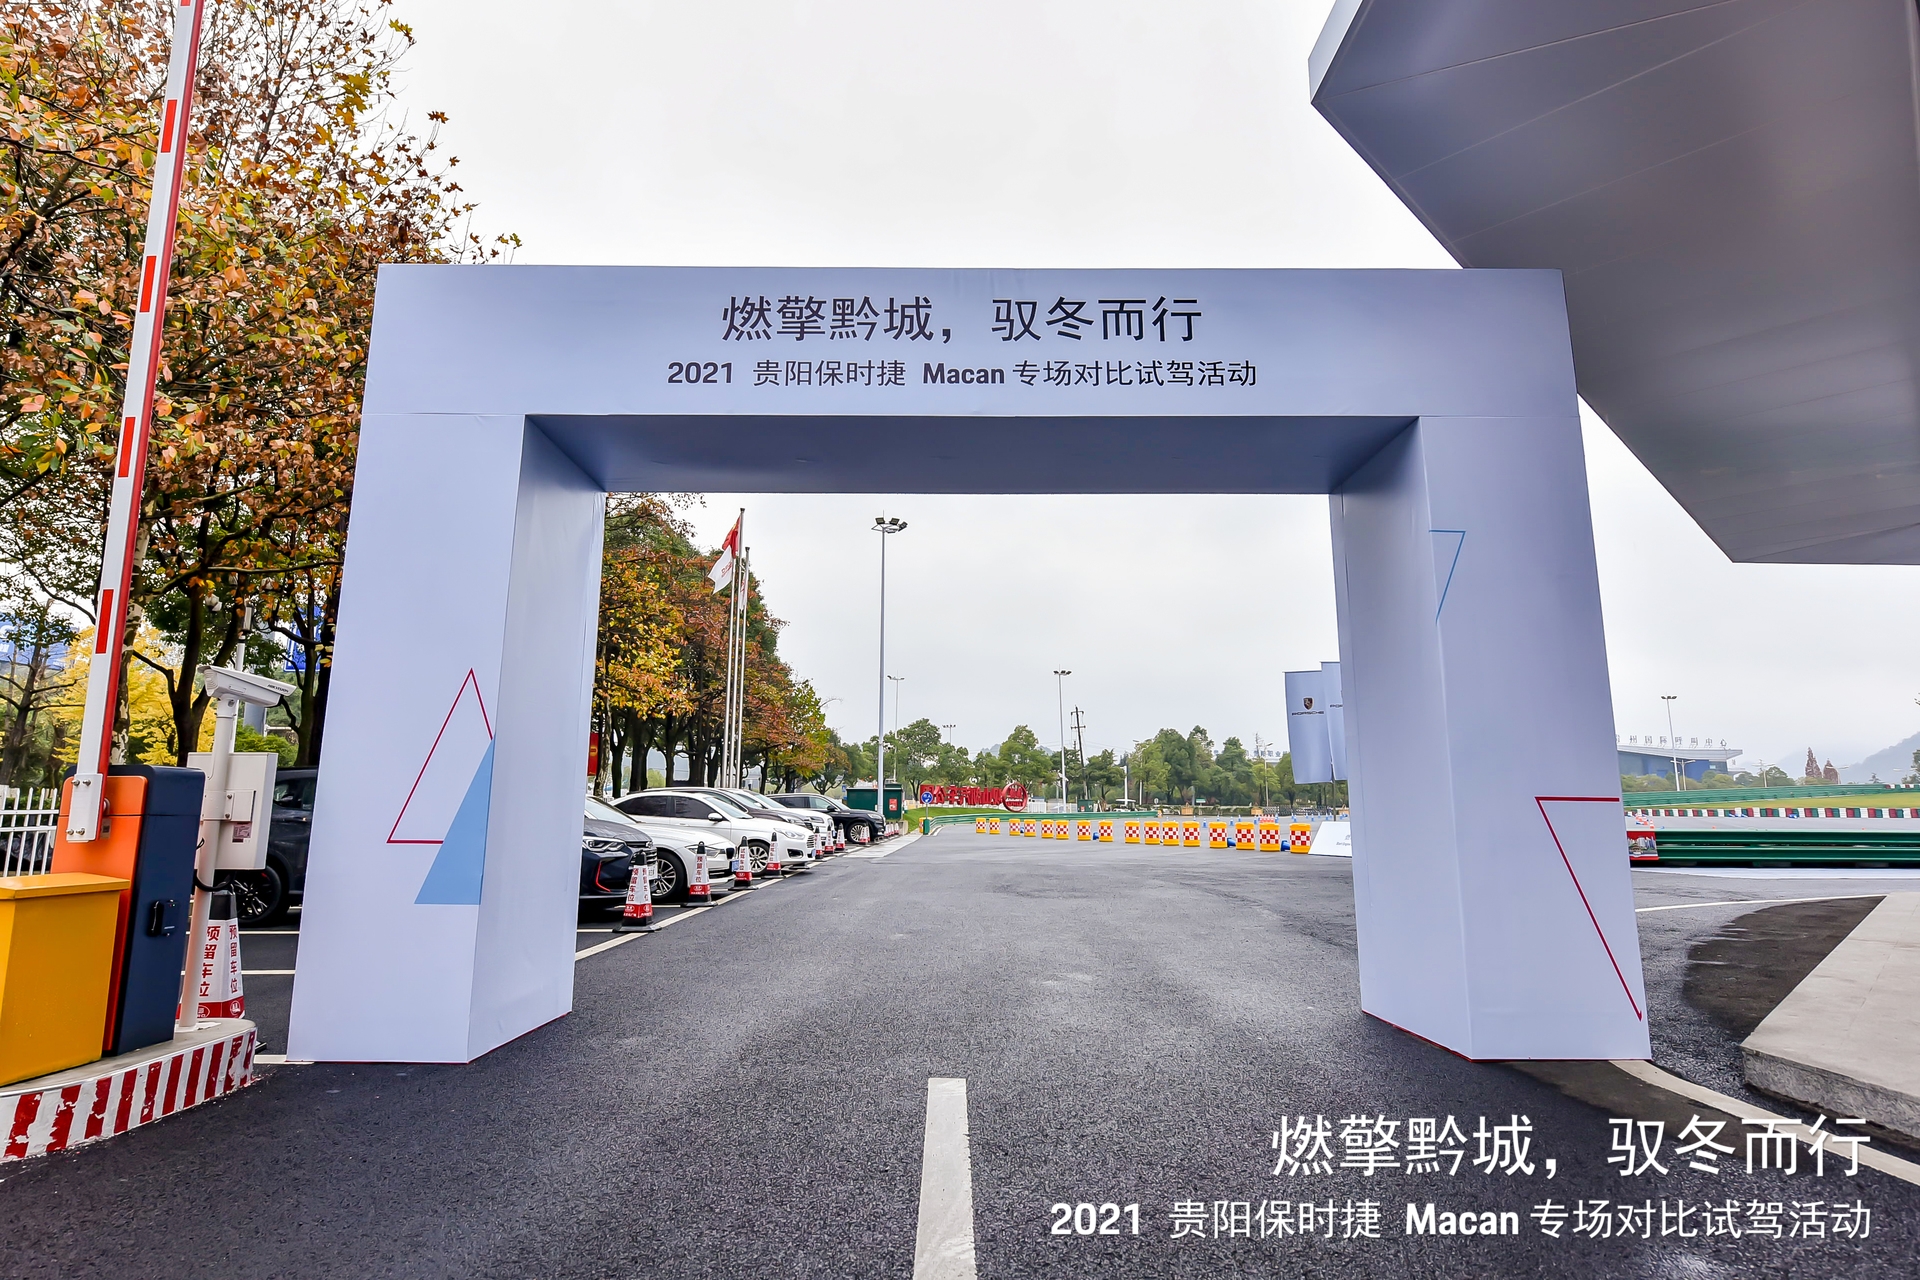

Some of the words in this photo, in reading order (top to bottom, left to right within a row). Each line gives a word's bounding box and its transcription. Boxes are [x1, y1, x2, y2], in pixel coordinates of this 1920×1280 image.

[721, 296, 1202, 343] 燃擎黔城，驭冬而行
[668, 362, 733, 384] 2021
[753, 360, 905, 386] 贵阳保时捷
[923, 364, 1004, 385] Macan
[1012, 360, 1257, 386] 专场对比试驾活动
[267, 683, 289, 693] HIKVISION
[229, 924, 238, 994] 预留车位
